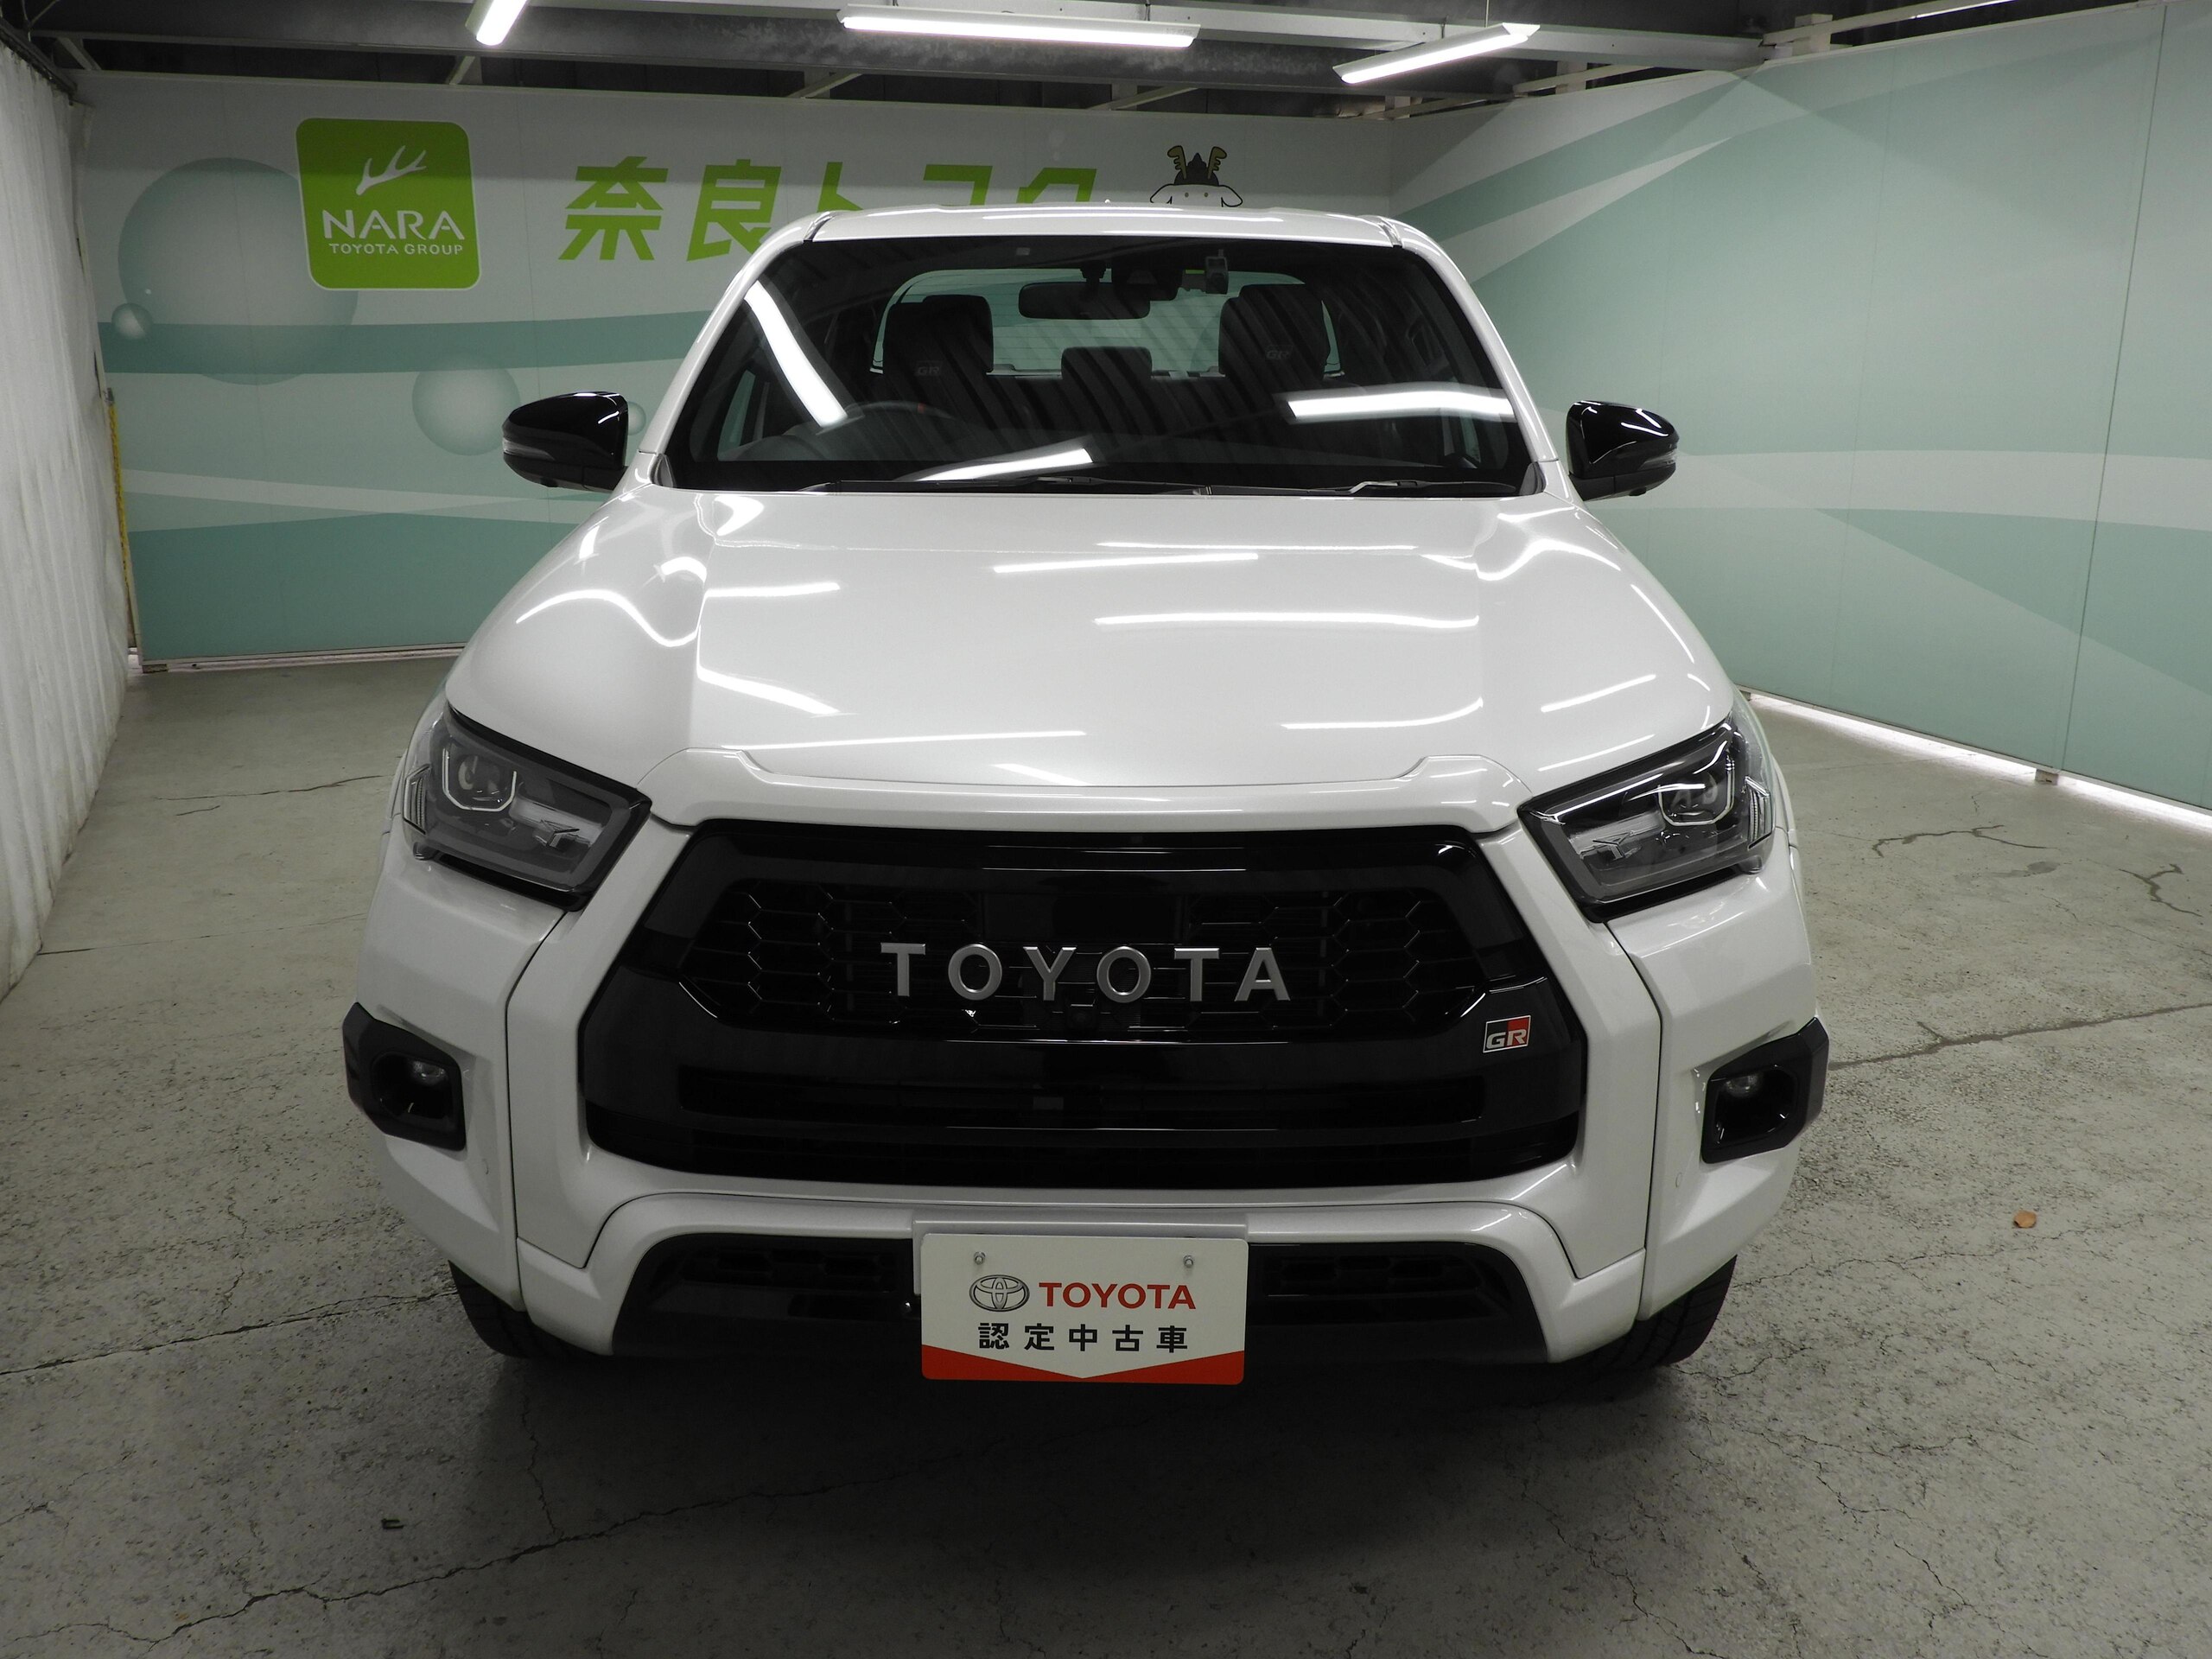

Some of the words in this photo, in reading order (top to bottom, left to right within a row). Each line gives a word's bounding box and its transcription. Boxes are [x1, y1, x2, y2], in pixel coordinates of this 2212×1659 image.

[322, 209, 465, 240] NARA
[328, 243, 399, 255] TOYOTA
[404, 244, 463, 255] GROUP
[917, 365, 940, 377] GR
[880, 942, 1291, 1003] TOYOTA
[1486, 1028, 1527, 1049] GR
[1038, 1281, 1197, 1310] TOYOTA
[977, 1322, 1188, 1353] 認定中古車
